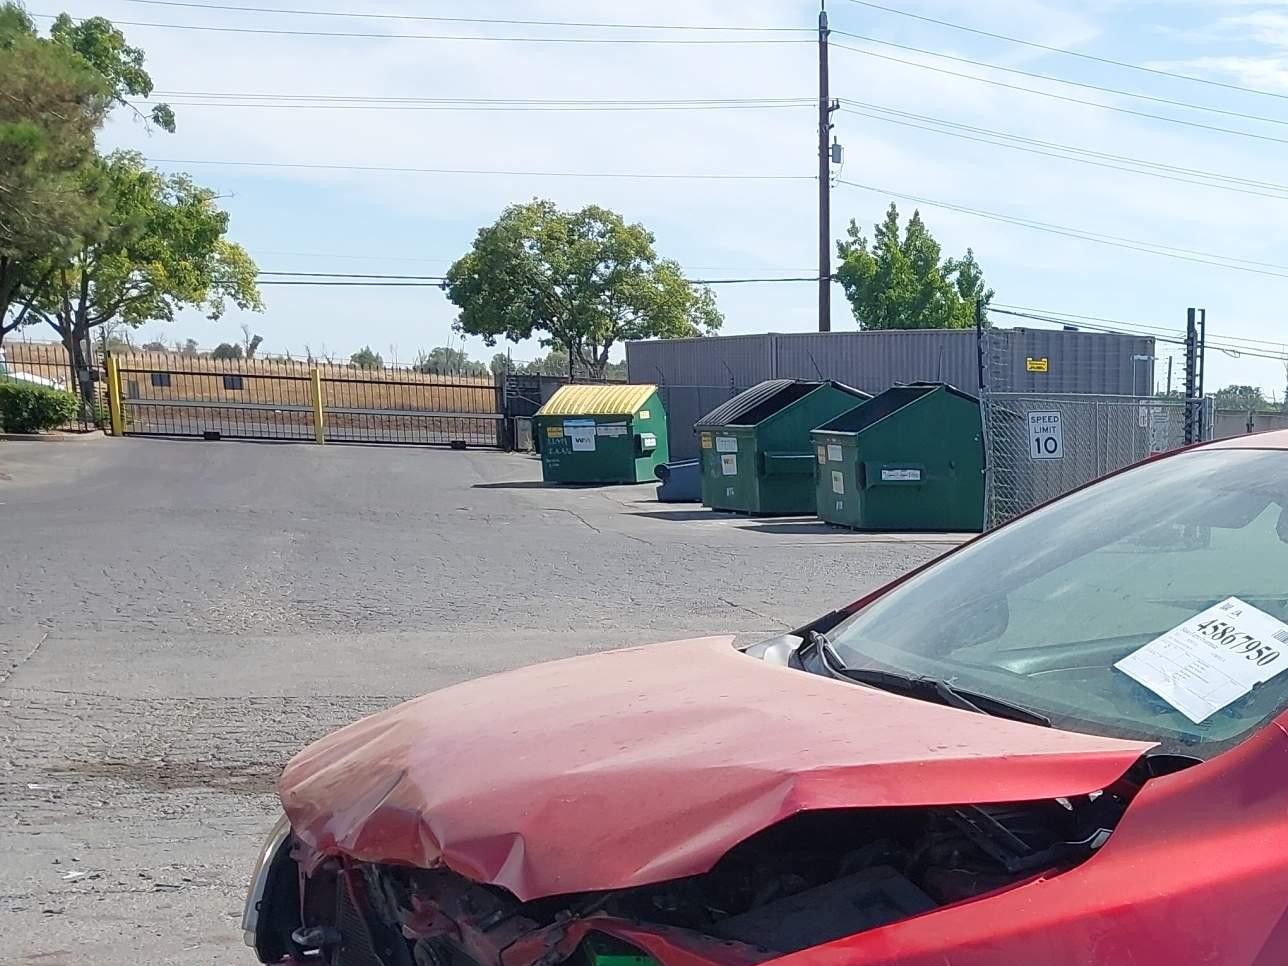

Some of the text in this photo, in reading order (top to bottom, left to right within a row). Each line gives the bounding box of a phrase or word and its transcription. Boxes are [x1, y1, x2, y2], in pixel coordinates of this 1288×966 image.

[1030, 416, 1059, 424] SPEED
[1034, 426, 1057, 434] LIMIT
[1035, 437, 1058, 454] 10
[1198, 619, 1280, 666] 45867950
